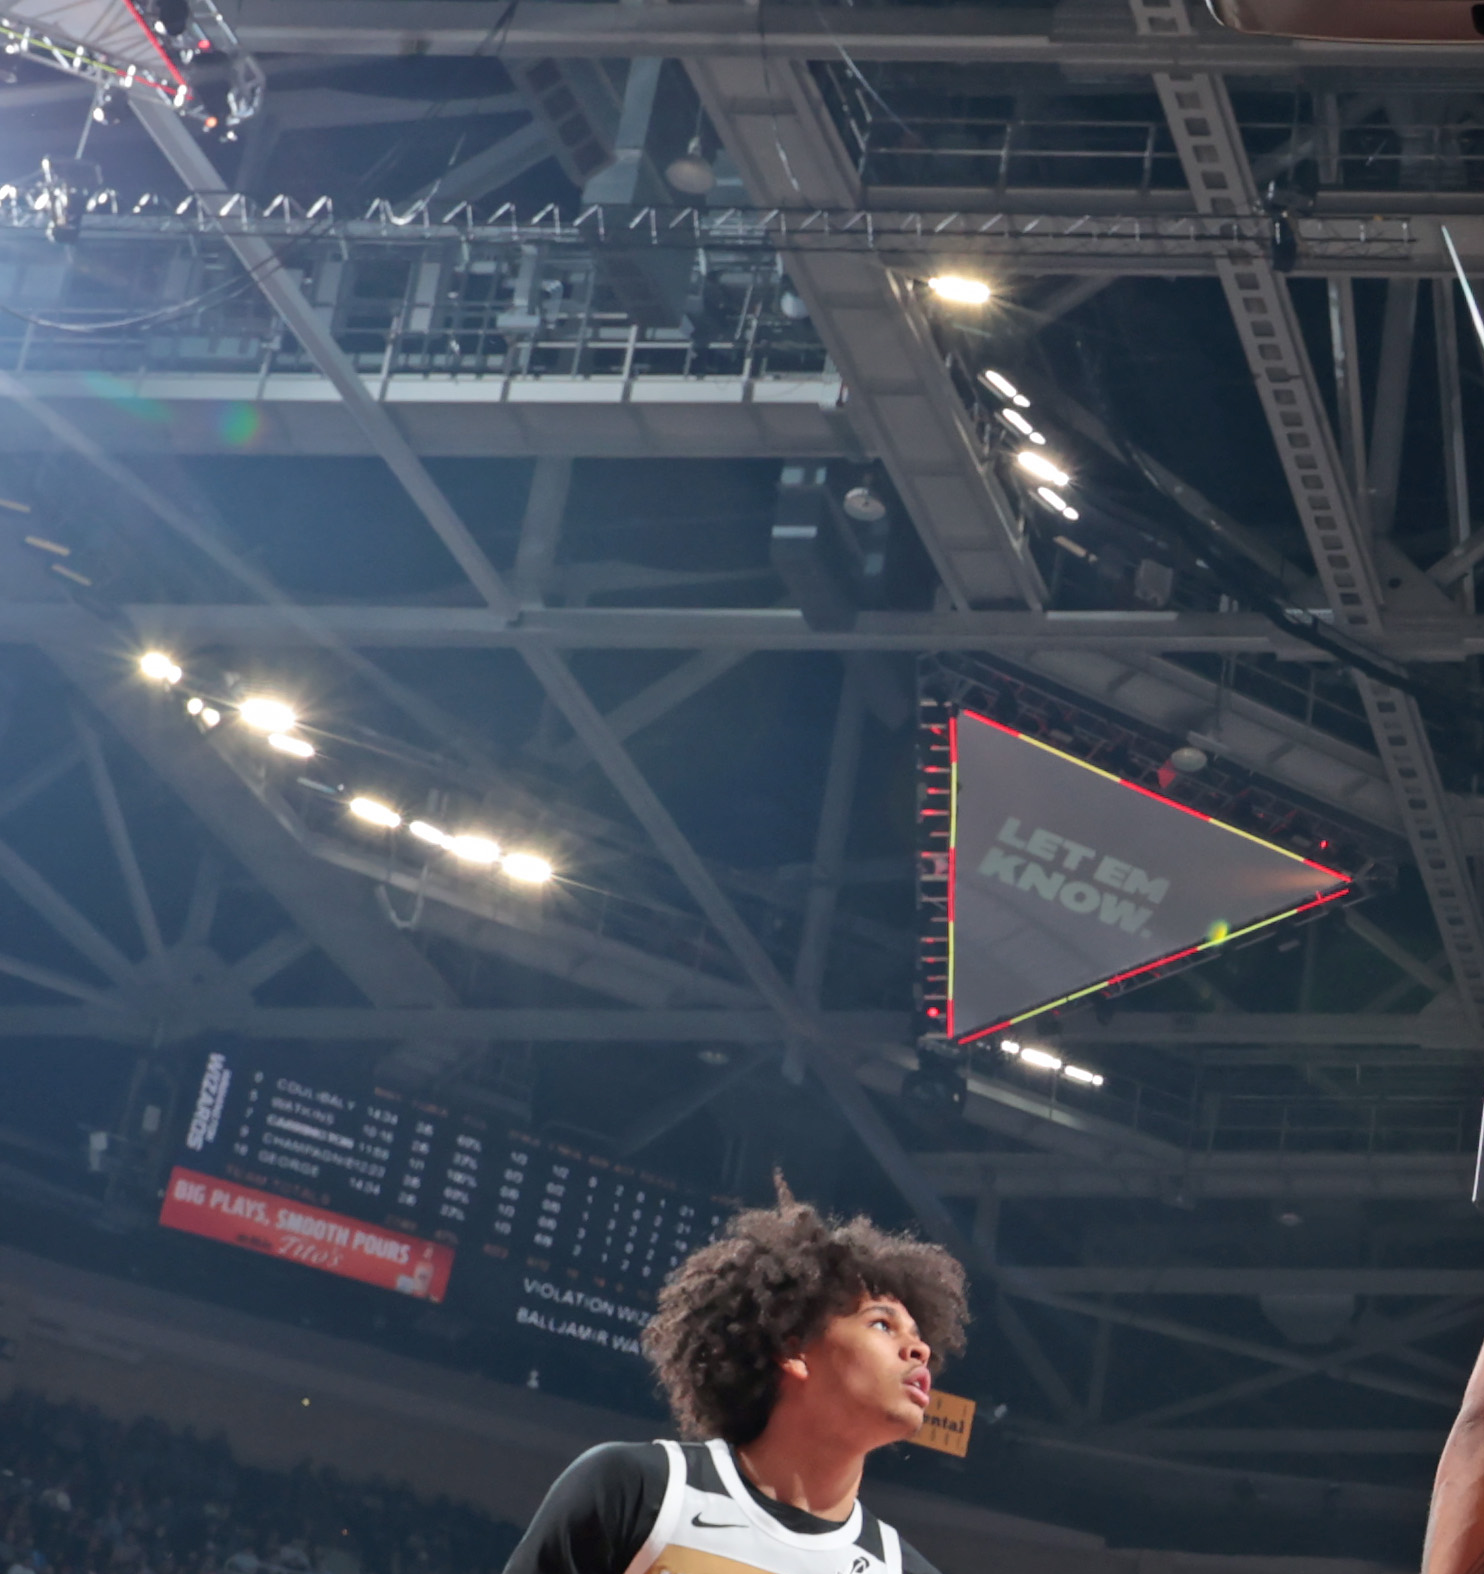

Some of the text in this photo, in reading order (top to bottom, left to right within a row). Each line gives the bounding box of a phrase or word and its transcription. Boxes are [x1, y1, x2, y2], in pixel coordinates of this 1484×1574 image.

[978, 845, 1154, 939] KNOW.
[997, 815, 1171, 905] LET EM
[185, 1051, 227, 1152] WIZARDS
[173, 1178, 206, 1205] BIG
[209, 1189, 271, 1227] PLAYS,
[275, 1208, 351, 1246] SMOOTH
[351, 1230, 411, 1264] POURS
[278, 1234, 344, 1268] Tito's
[523, 1276, 615, 1317] VIOLATION
